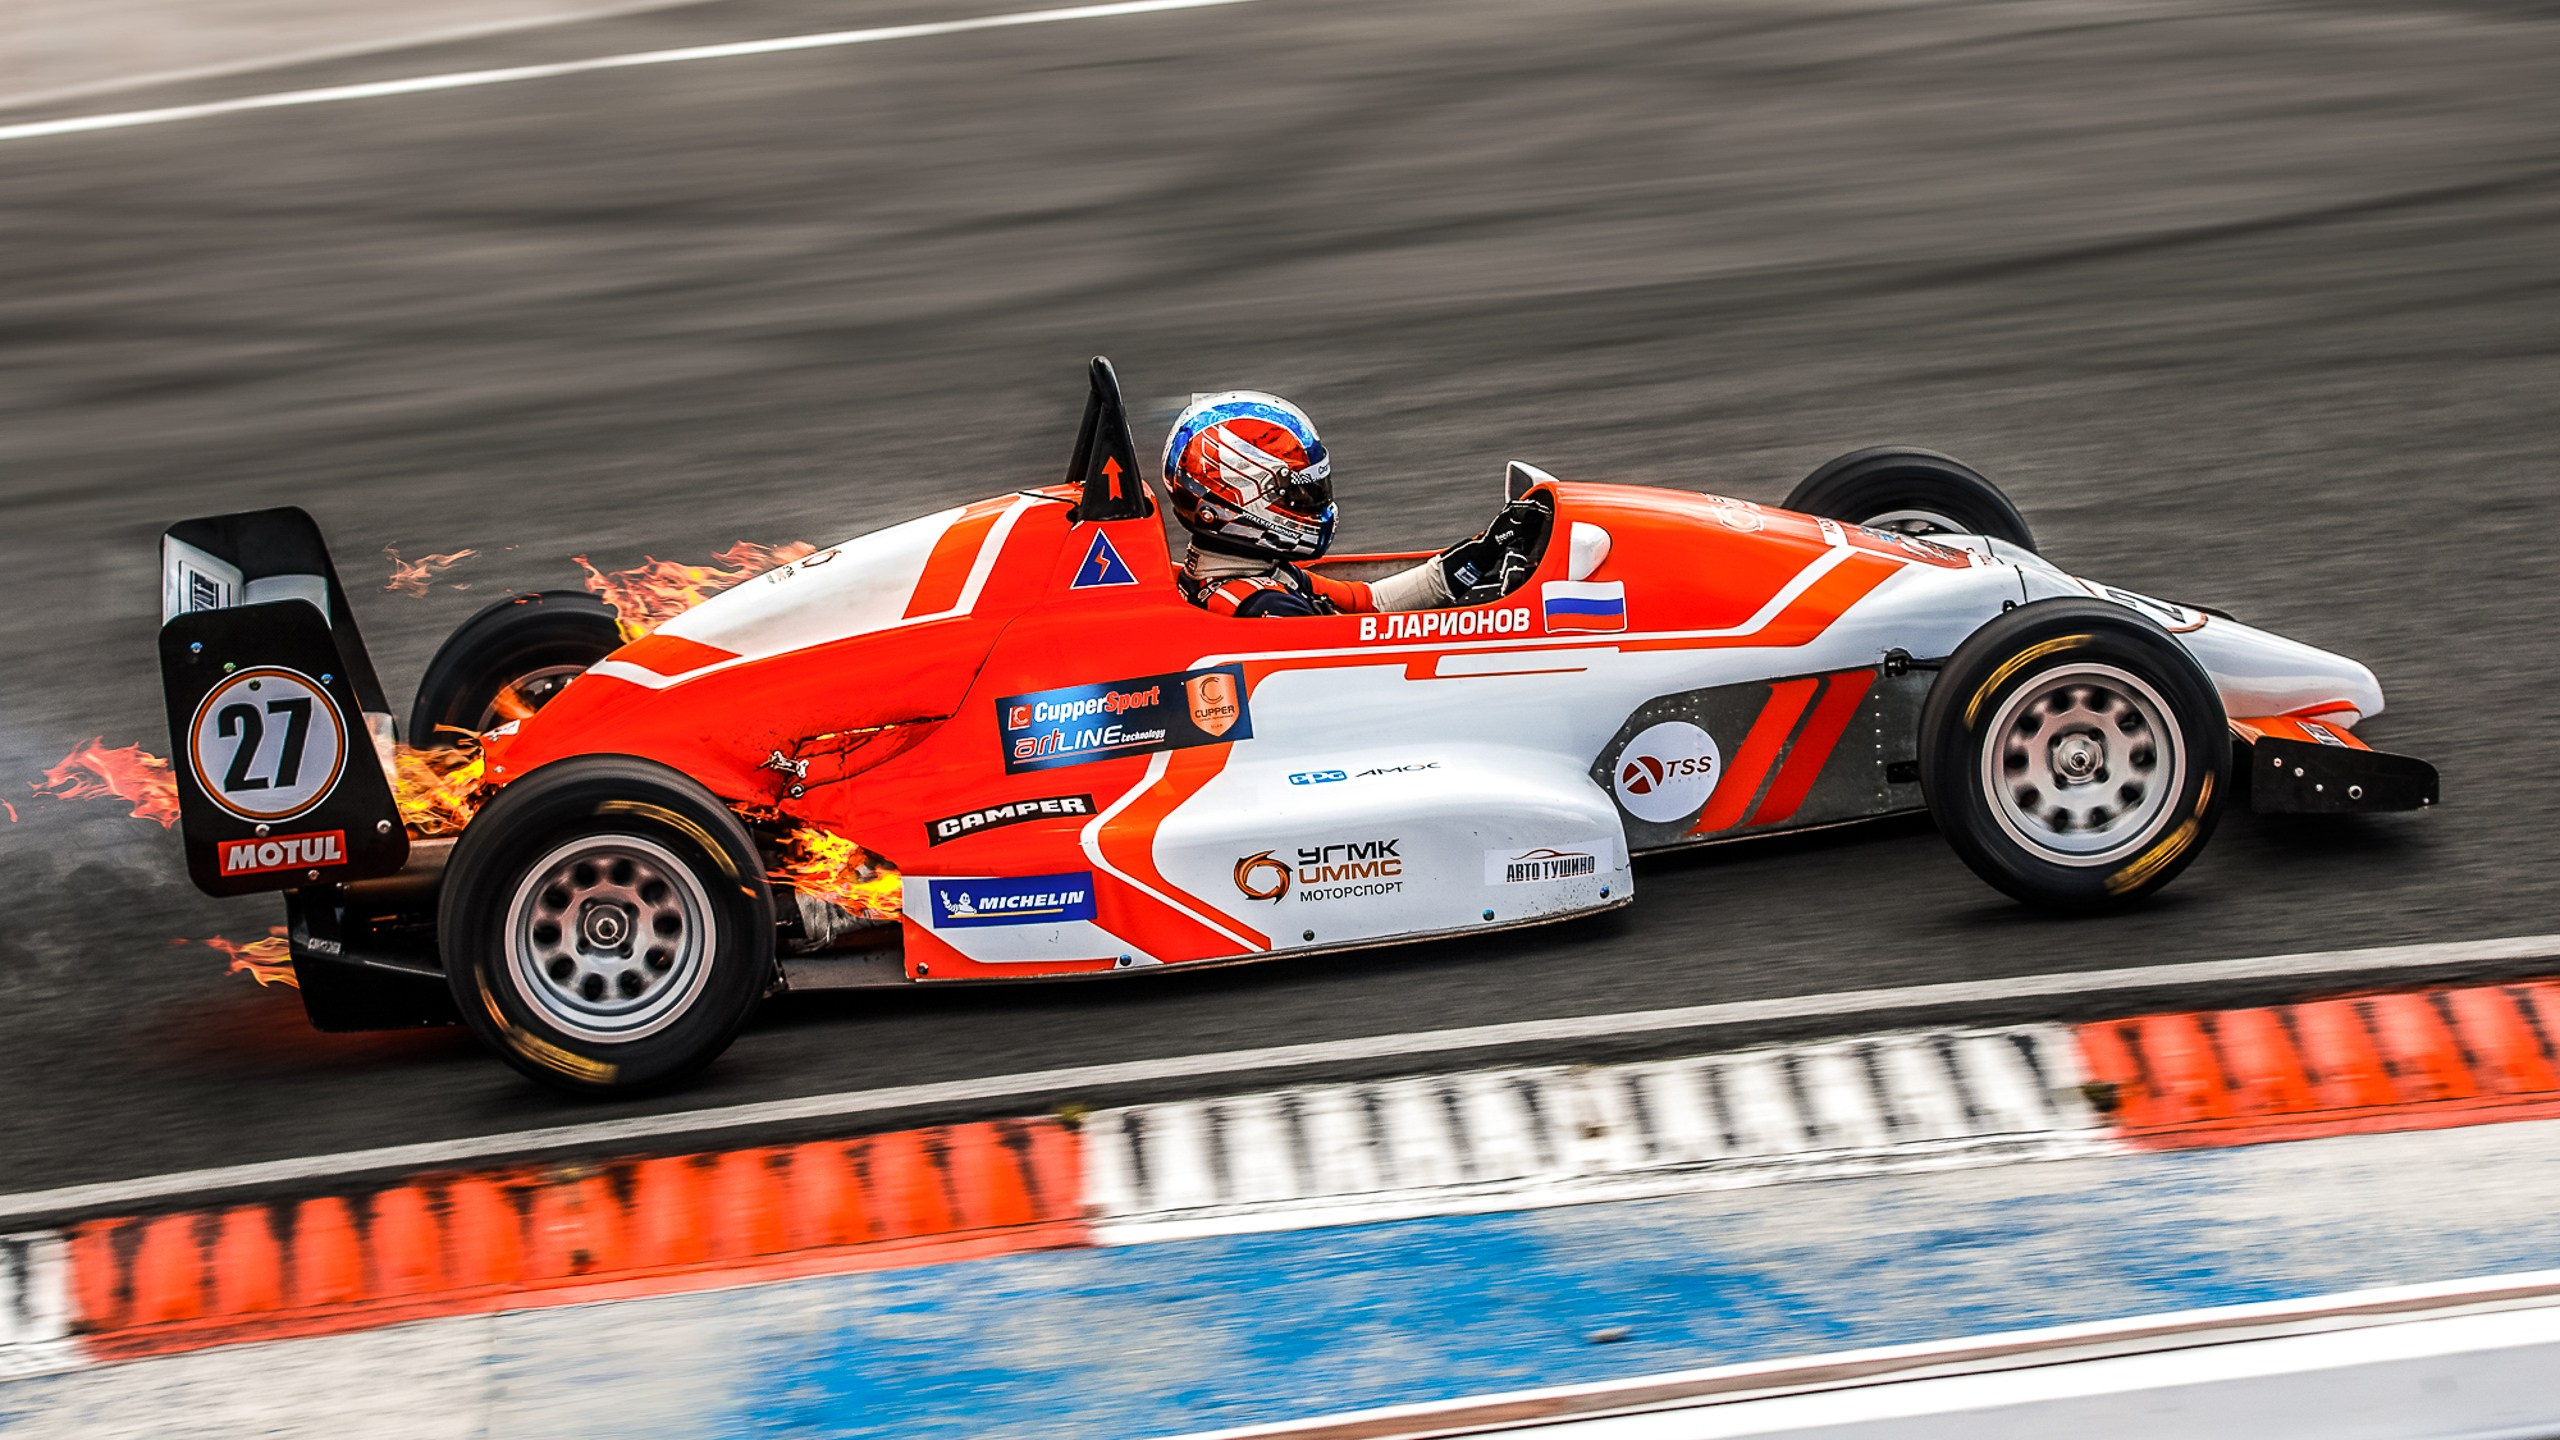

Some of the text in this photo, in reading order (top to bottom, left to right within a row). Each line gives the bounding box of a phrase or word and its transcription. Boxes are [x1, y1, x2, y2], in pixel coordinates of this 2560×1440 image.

[1359, 607, 1530, 641] В.ЛАРИОНОВ
[1034, 686, 1160, 723] CupperSport
[1194, 704, 1235, 719] CUPPER
[218, 697, 312, 793] 27
[1121, 728, 1166, 743] technology
[1666, 755, 1712, 778] TSS
[937, 797, 1087, 838] CAMPER
[227, 836, 341, 871] MOTUL
[1297, 838, 1400, 866] УГМК
[1299, 860, 1402, 883] UMMC
[1507, 855, 1595, 882] АВТО ТУШИНО
[978, 890, 1085, 911] MICHELIN
[1300, 881, 1403, 903] МОТОРСПОРТ
